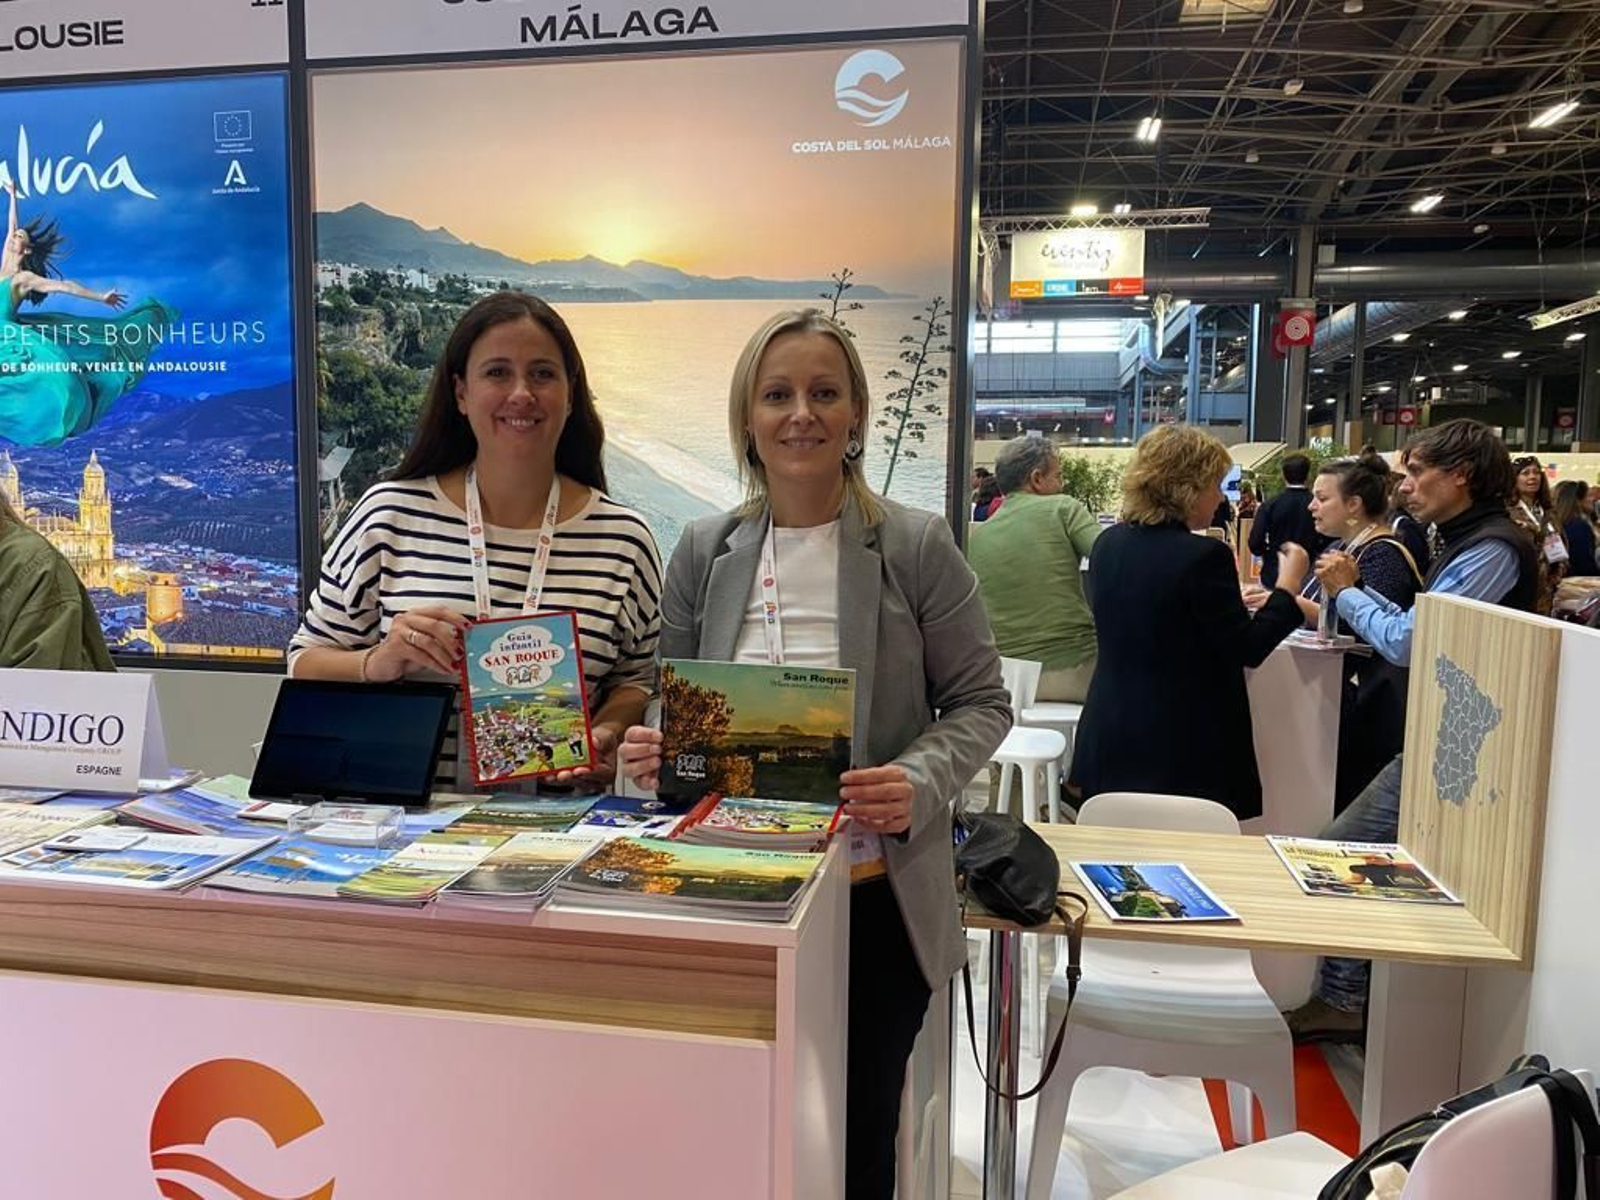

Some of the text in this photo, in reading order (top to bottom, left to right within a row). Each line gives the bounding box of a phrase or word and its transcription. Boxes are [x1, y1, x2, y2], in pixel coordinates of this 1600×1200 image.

[520, 5, 719, 43] MÁLAGA
[792, 135, 951, 153] COSTA DEL SOL MÁLAGA
[3, 320, 265, 346] PETITS BONHEURS
[2, 361, 227, 374] DE BONHEUR, VENEZ EN ANDALOUSIE
[500, 641, 542, 652] infantil
[484, 650, 560, 668] SAN ROQUE
[783, 672, 849, 685] San Roque
[0, 710, 124, 746] NDIGO
[76, 765, 122, 776] ESPAGNE
